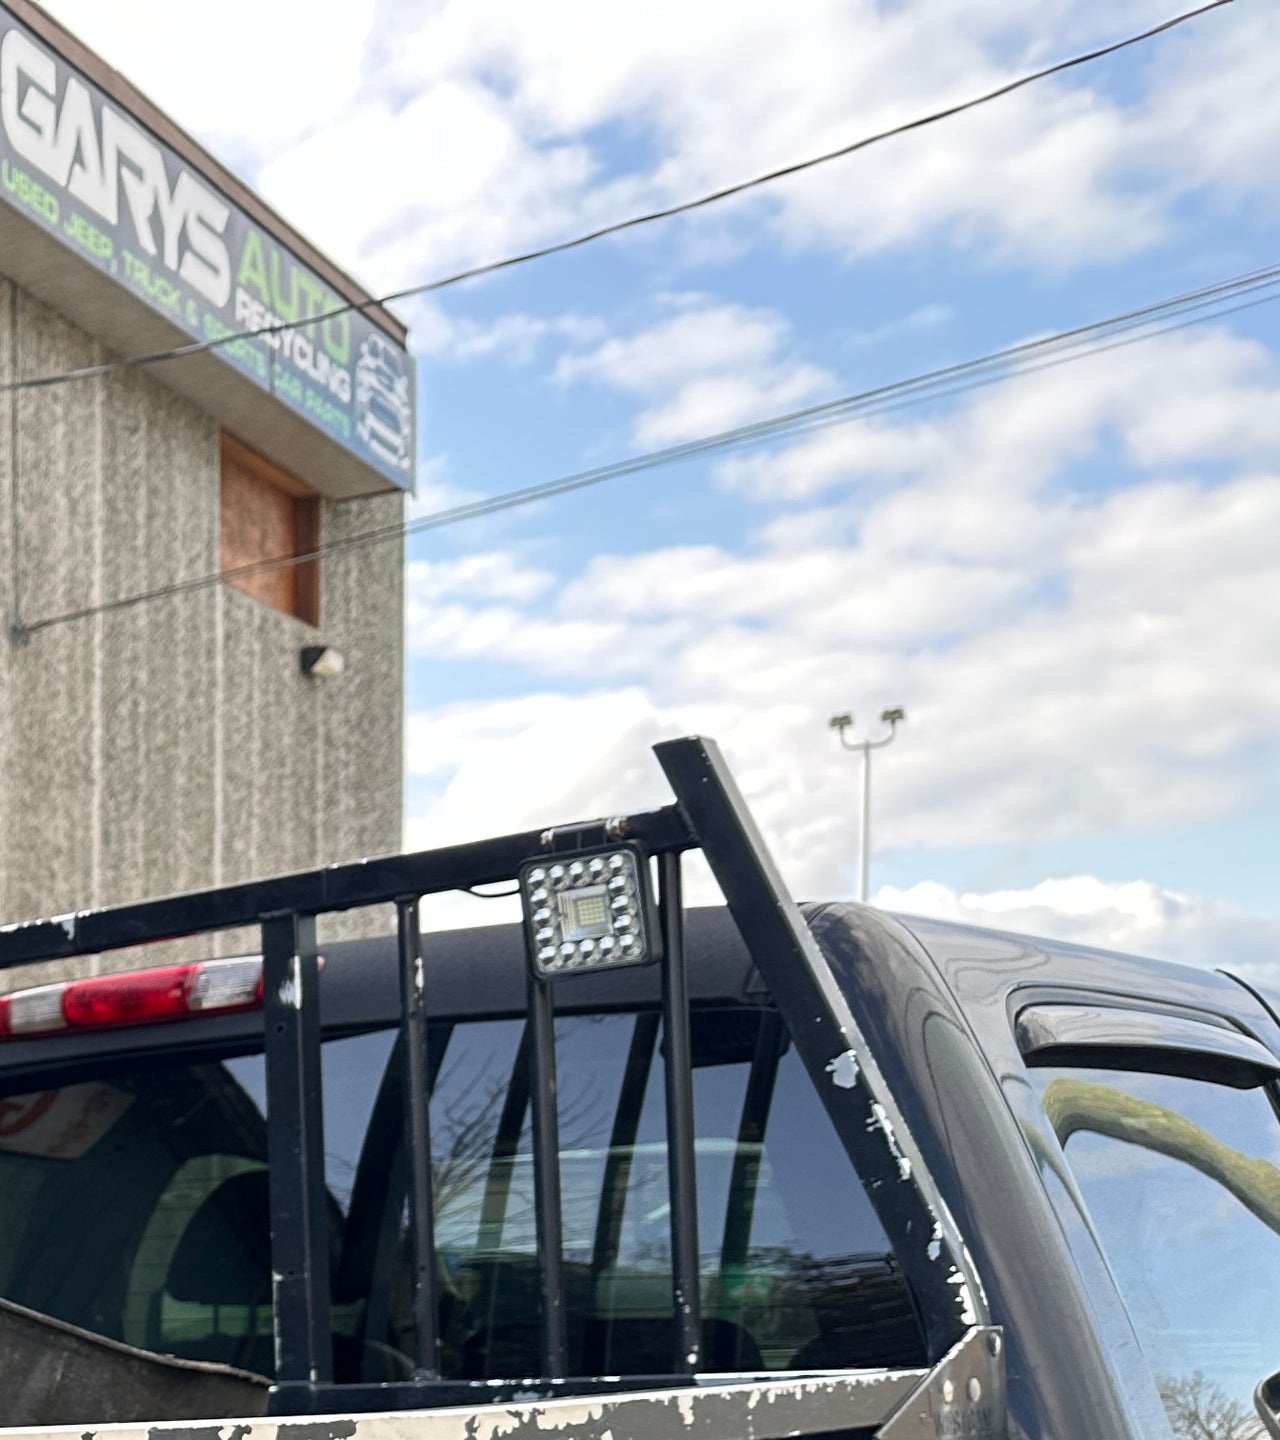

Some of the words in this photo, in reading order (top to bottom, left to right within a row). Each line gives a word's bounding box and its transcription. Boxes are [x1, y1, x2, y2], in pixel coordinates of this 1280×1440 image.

[1, 29, 229, 309] GARYS
[1, 159, 59, 224] USED
[122, 249, 181, 314] TRUCK
[235, 287, 352, 404] RECYCLING
[238, 230, 351, 366] AUTO
